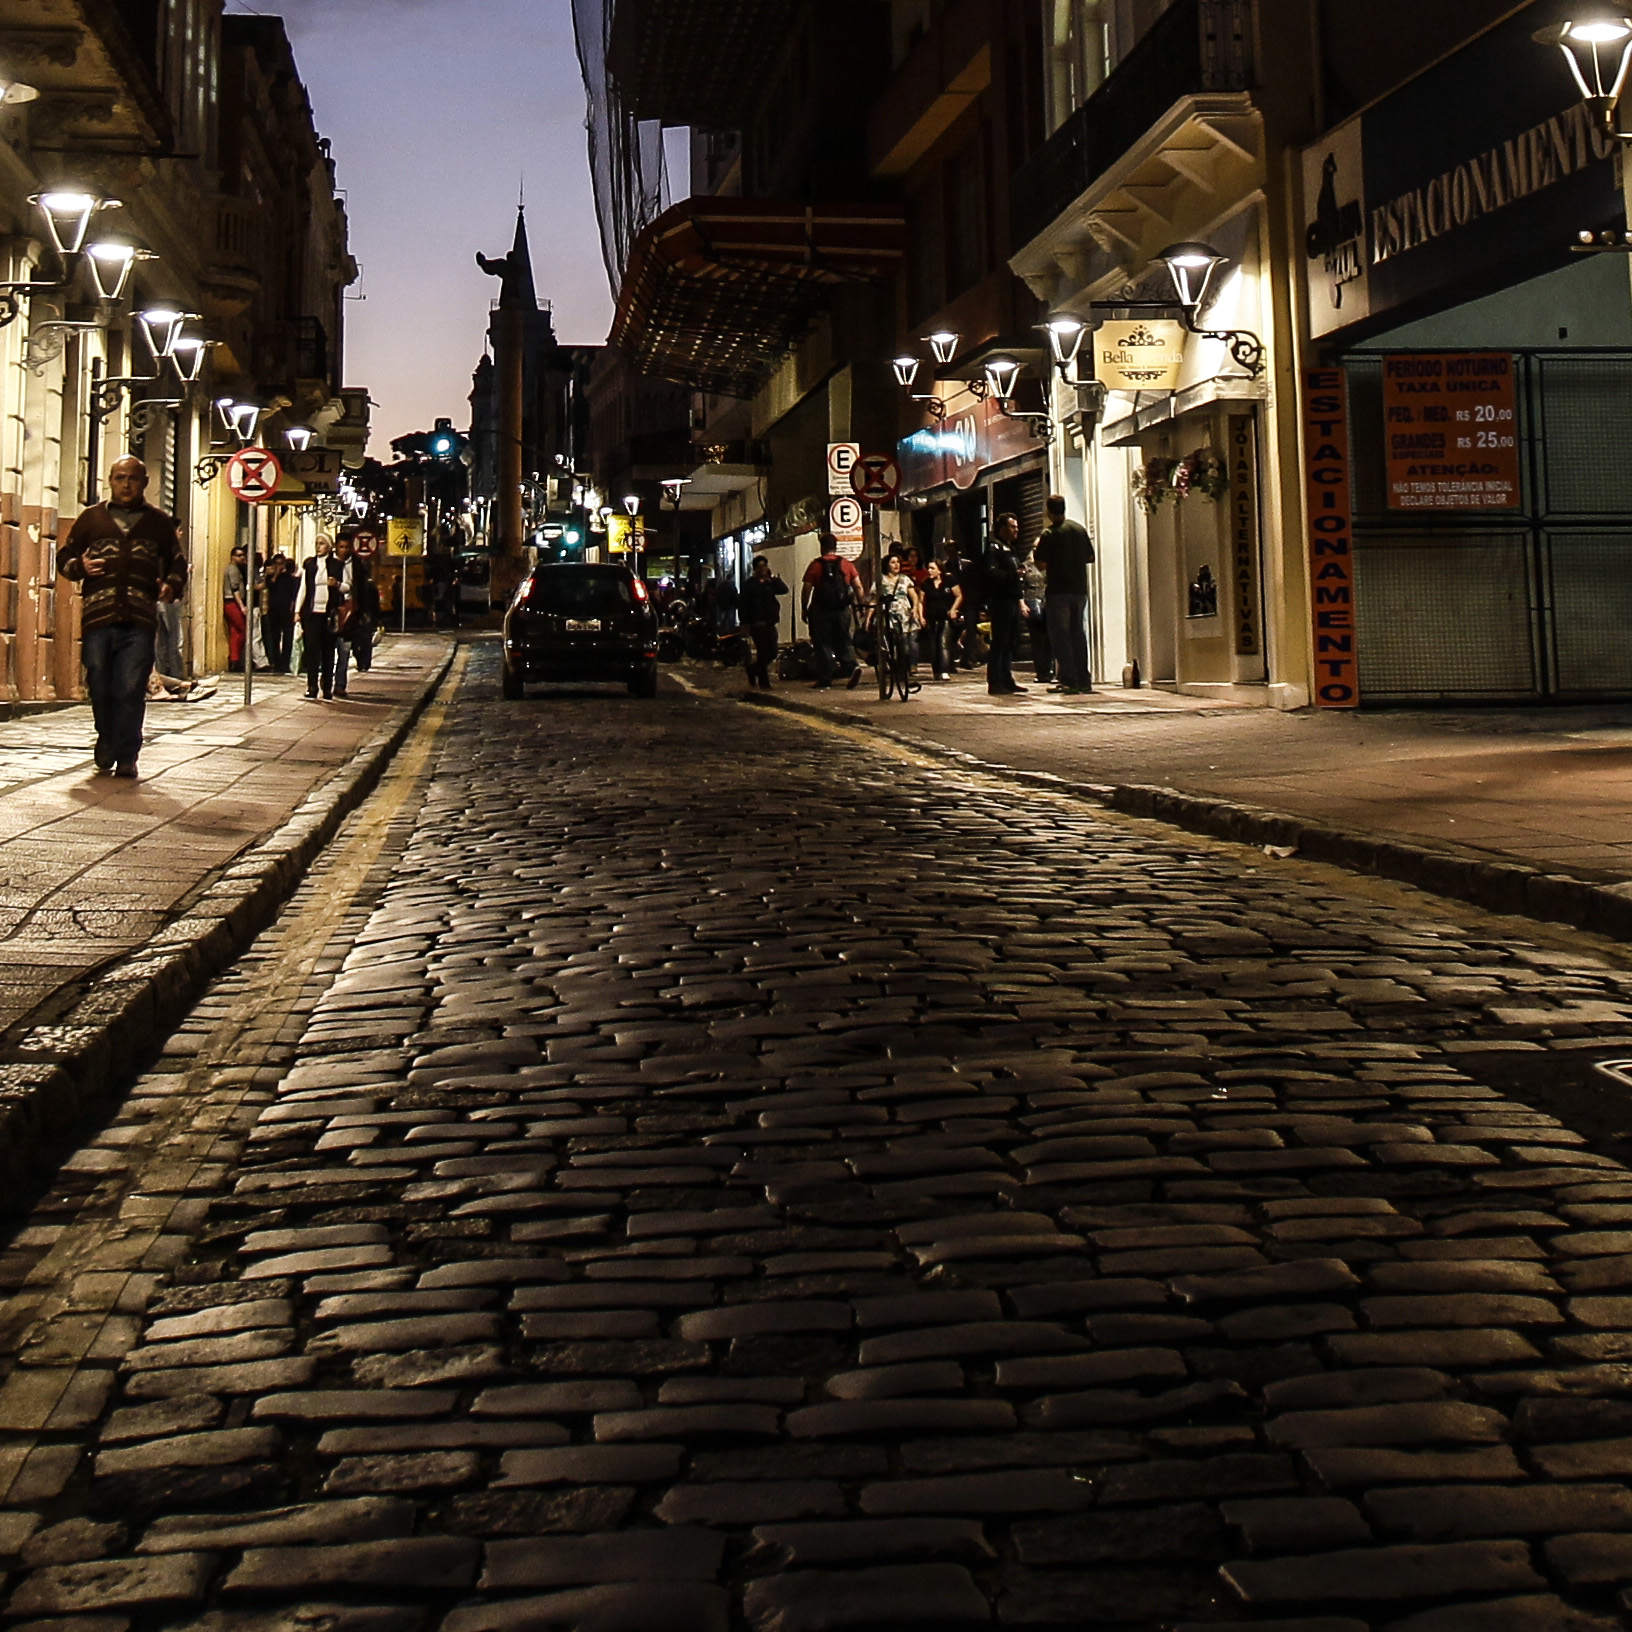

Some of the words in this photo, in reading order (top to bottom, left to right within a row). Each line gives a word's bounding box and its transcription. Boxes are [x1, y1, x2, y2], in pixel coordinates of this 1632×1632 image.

[1371, 101, 1616, 266] ESTACIONAMENTO
[1102, 350, 1134, 364] Bella
[1446, 357, 1508, 377] NOTURNO
[1395, 381, 1441, 393] TAXA
[1474, 404, 1513, 422] 20,00
[1476, 431, 1514, 449] 25,00
[836, 449, 850, 469] E
[1235, 421, 1249, 485] JOIAS
[840, 504, 851, 523] E
[1307, 371, 1354, 702] ESTACIONAMENTO
[1236, 490, 1253, 647] ALTERNATIVAS
